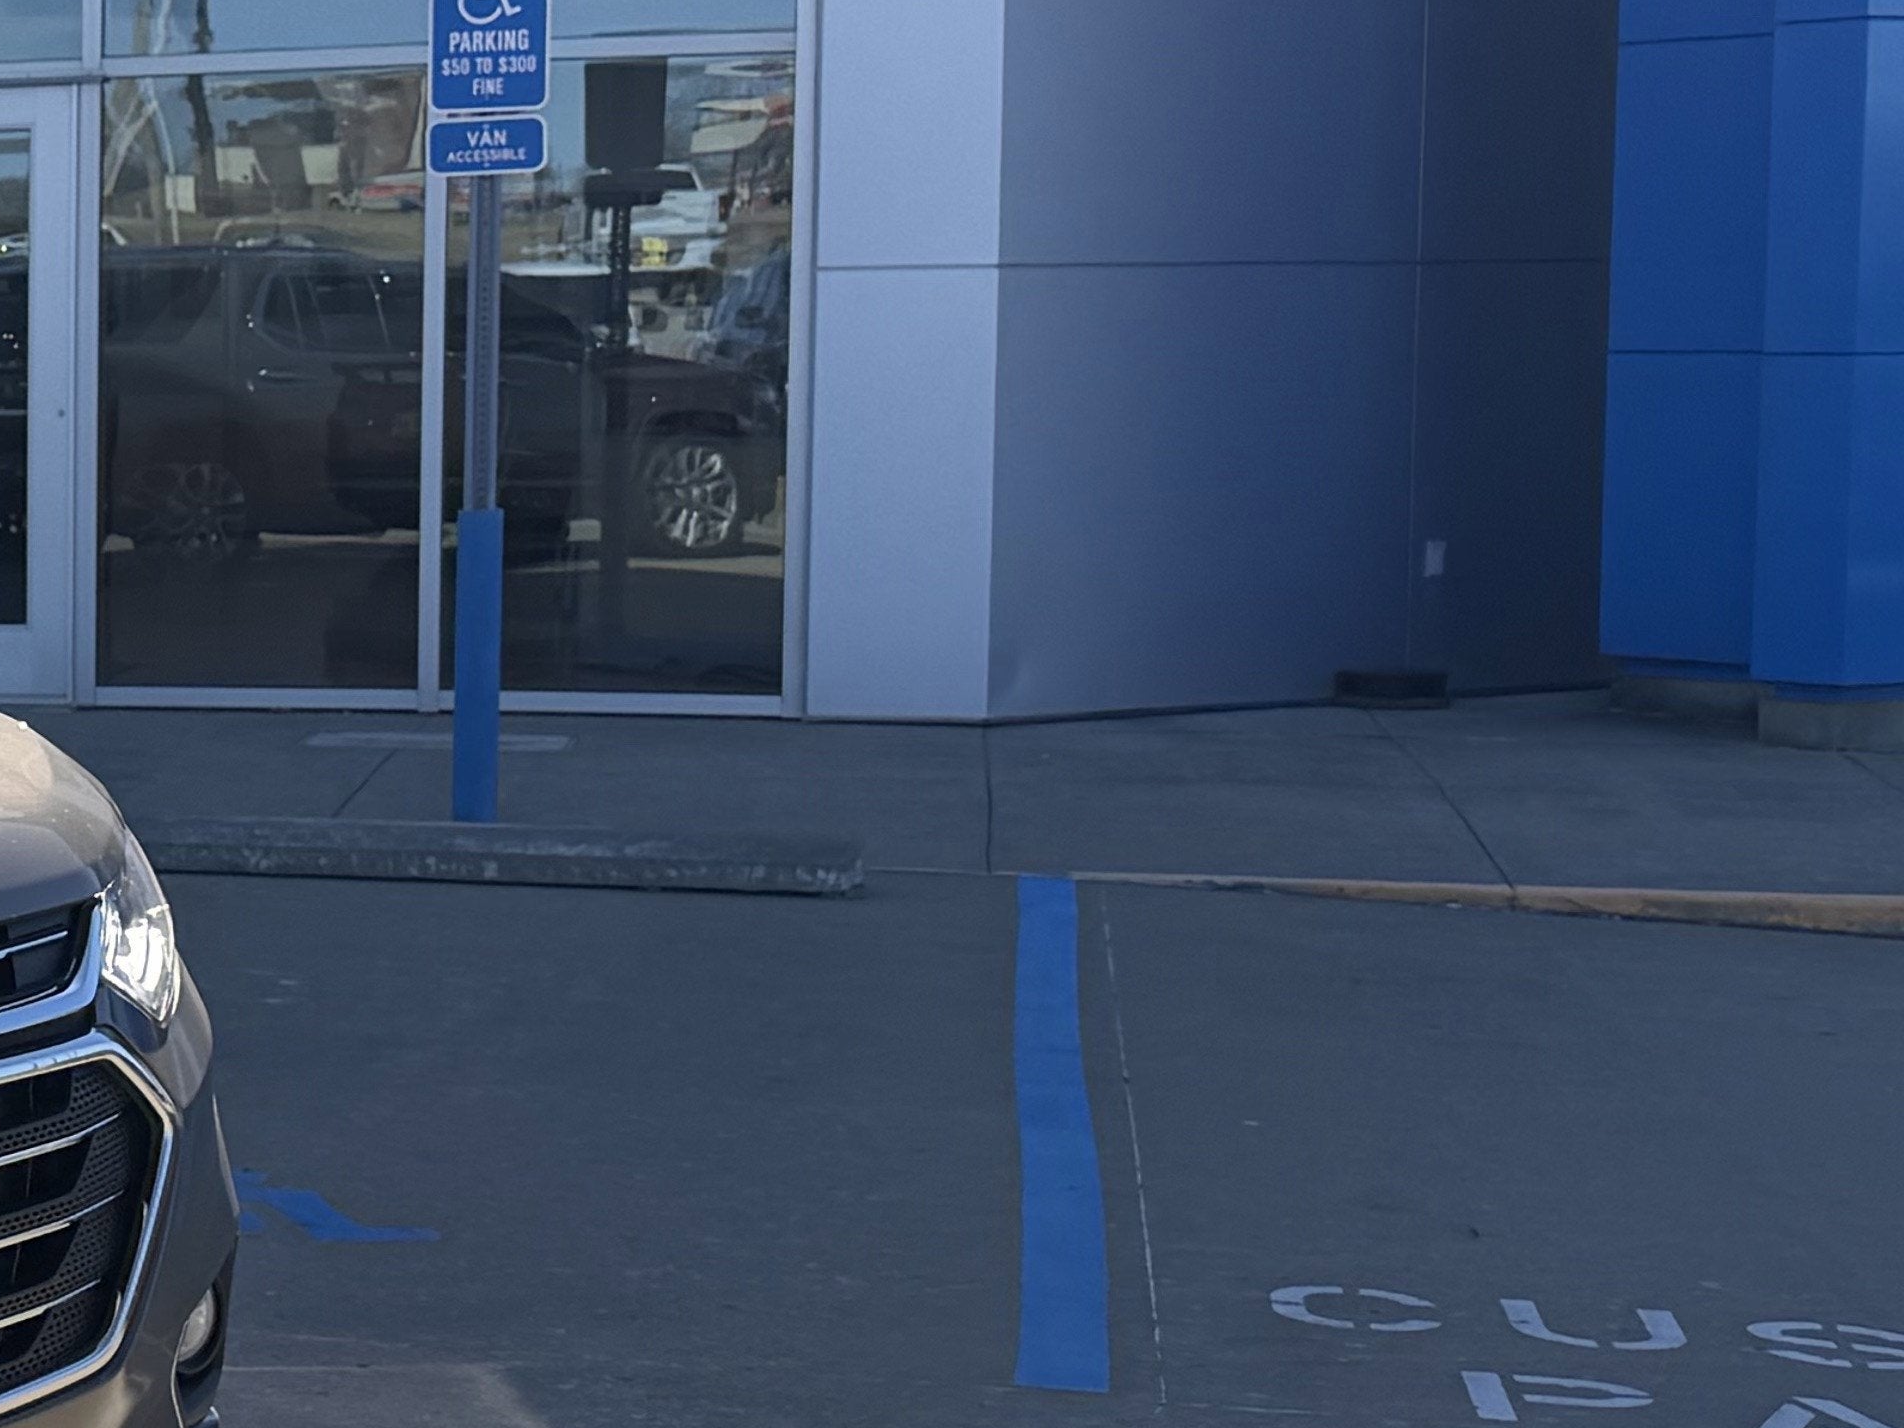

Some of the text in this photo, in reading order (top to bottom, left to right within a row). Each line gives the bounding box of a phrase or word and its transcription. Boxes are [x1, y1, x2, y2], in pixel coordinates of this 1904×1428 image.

[448, 29, 529, 53] PARKING
[441, 54, 537, 76] $50 TO $300
[472, 76, 504, 96] FINE
[466, 129, 507, 147] VAN
[446, 147, 527, 163] ACCESSIBLE
